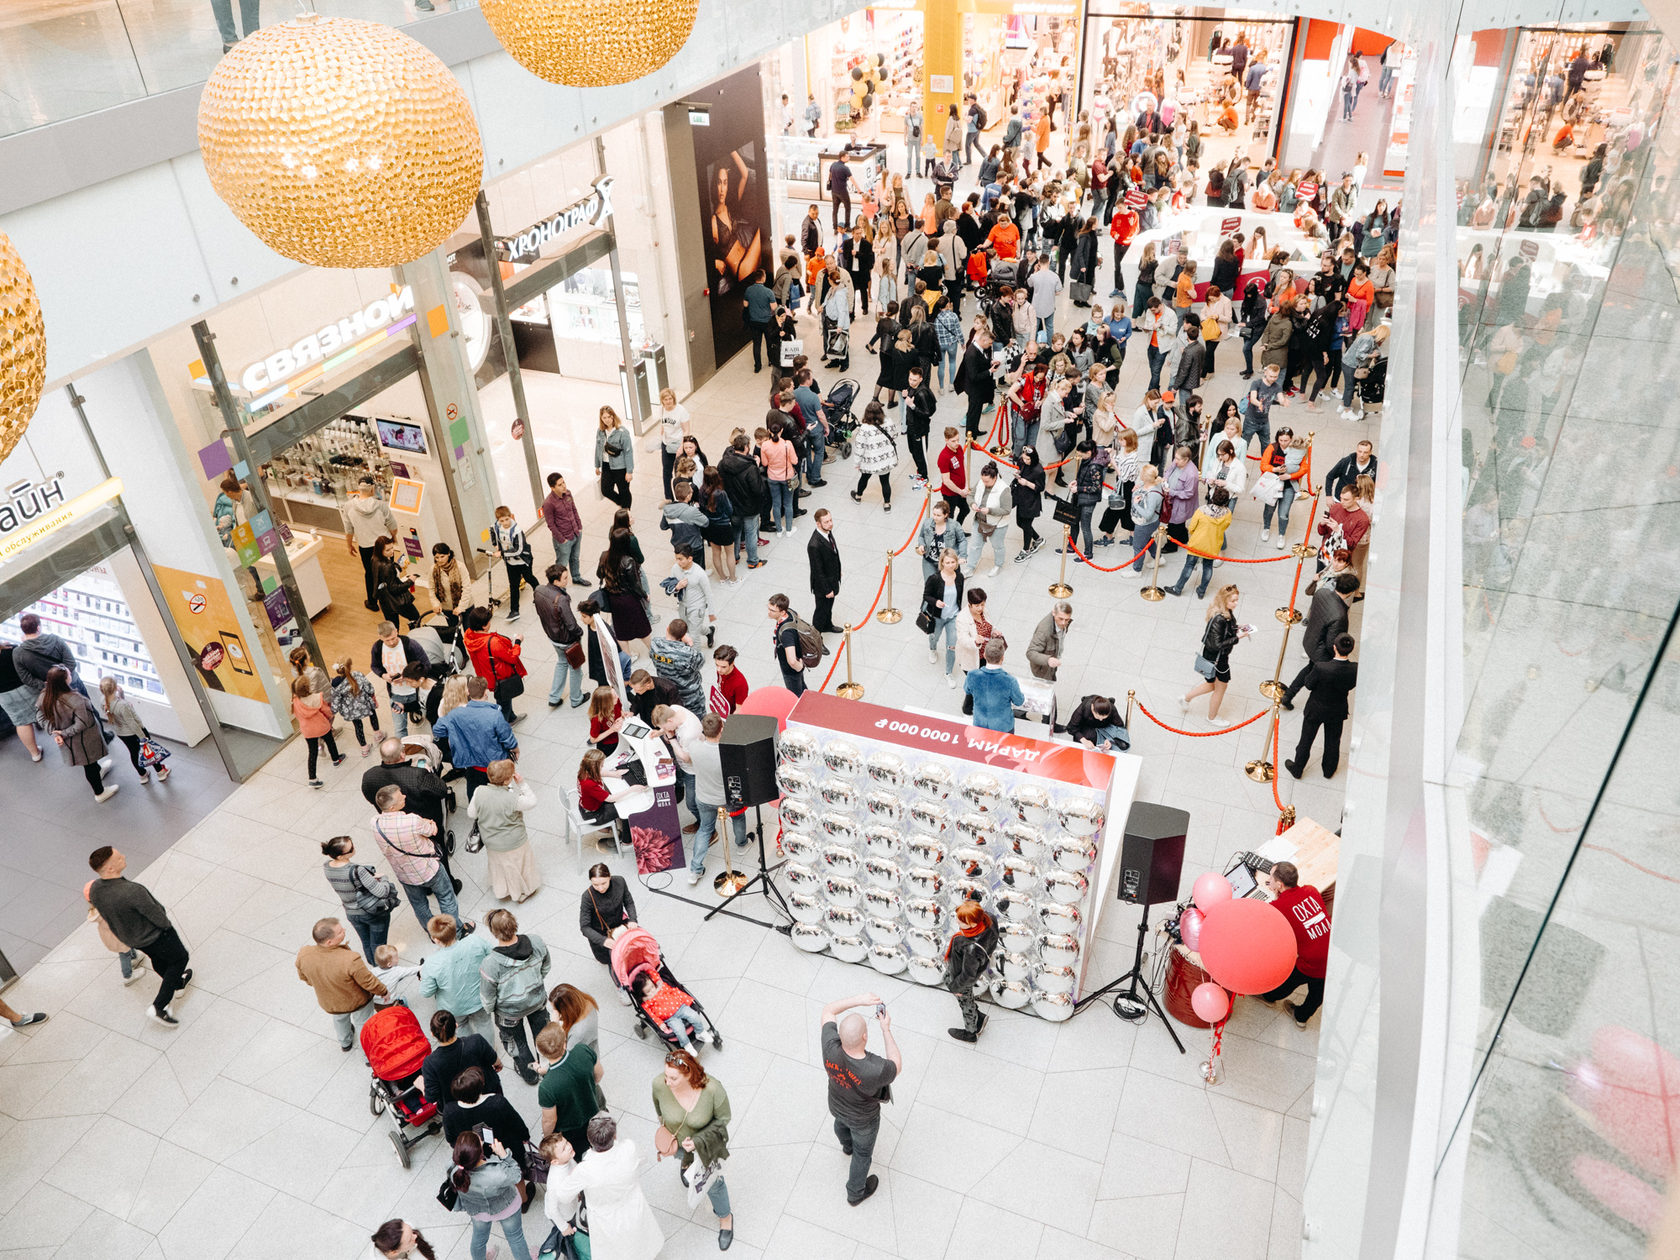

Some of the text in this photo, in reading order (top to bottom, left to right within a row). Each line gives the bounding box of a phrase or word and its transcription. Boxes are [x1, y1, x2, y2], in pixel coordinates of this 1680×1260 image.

[508, 198, 600, 262] ХРОНОГРАФ
[242, 284, 415, 393] СВЯЗНОЙ
[4, 511, 73, 554] обслуживания
[889, 721, 919, 737] 000
[920, 727, 952, 743] 000
[951, 733, 960, 745] 1
[968, 739, 1040, 762] ДАРИМ
[1292, 896, 1322, 922] ОХТА
